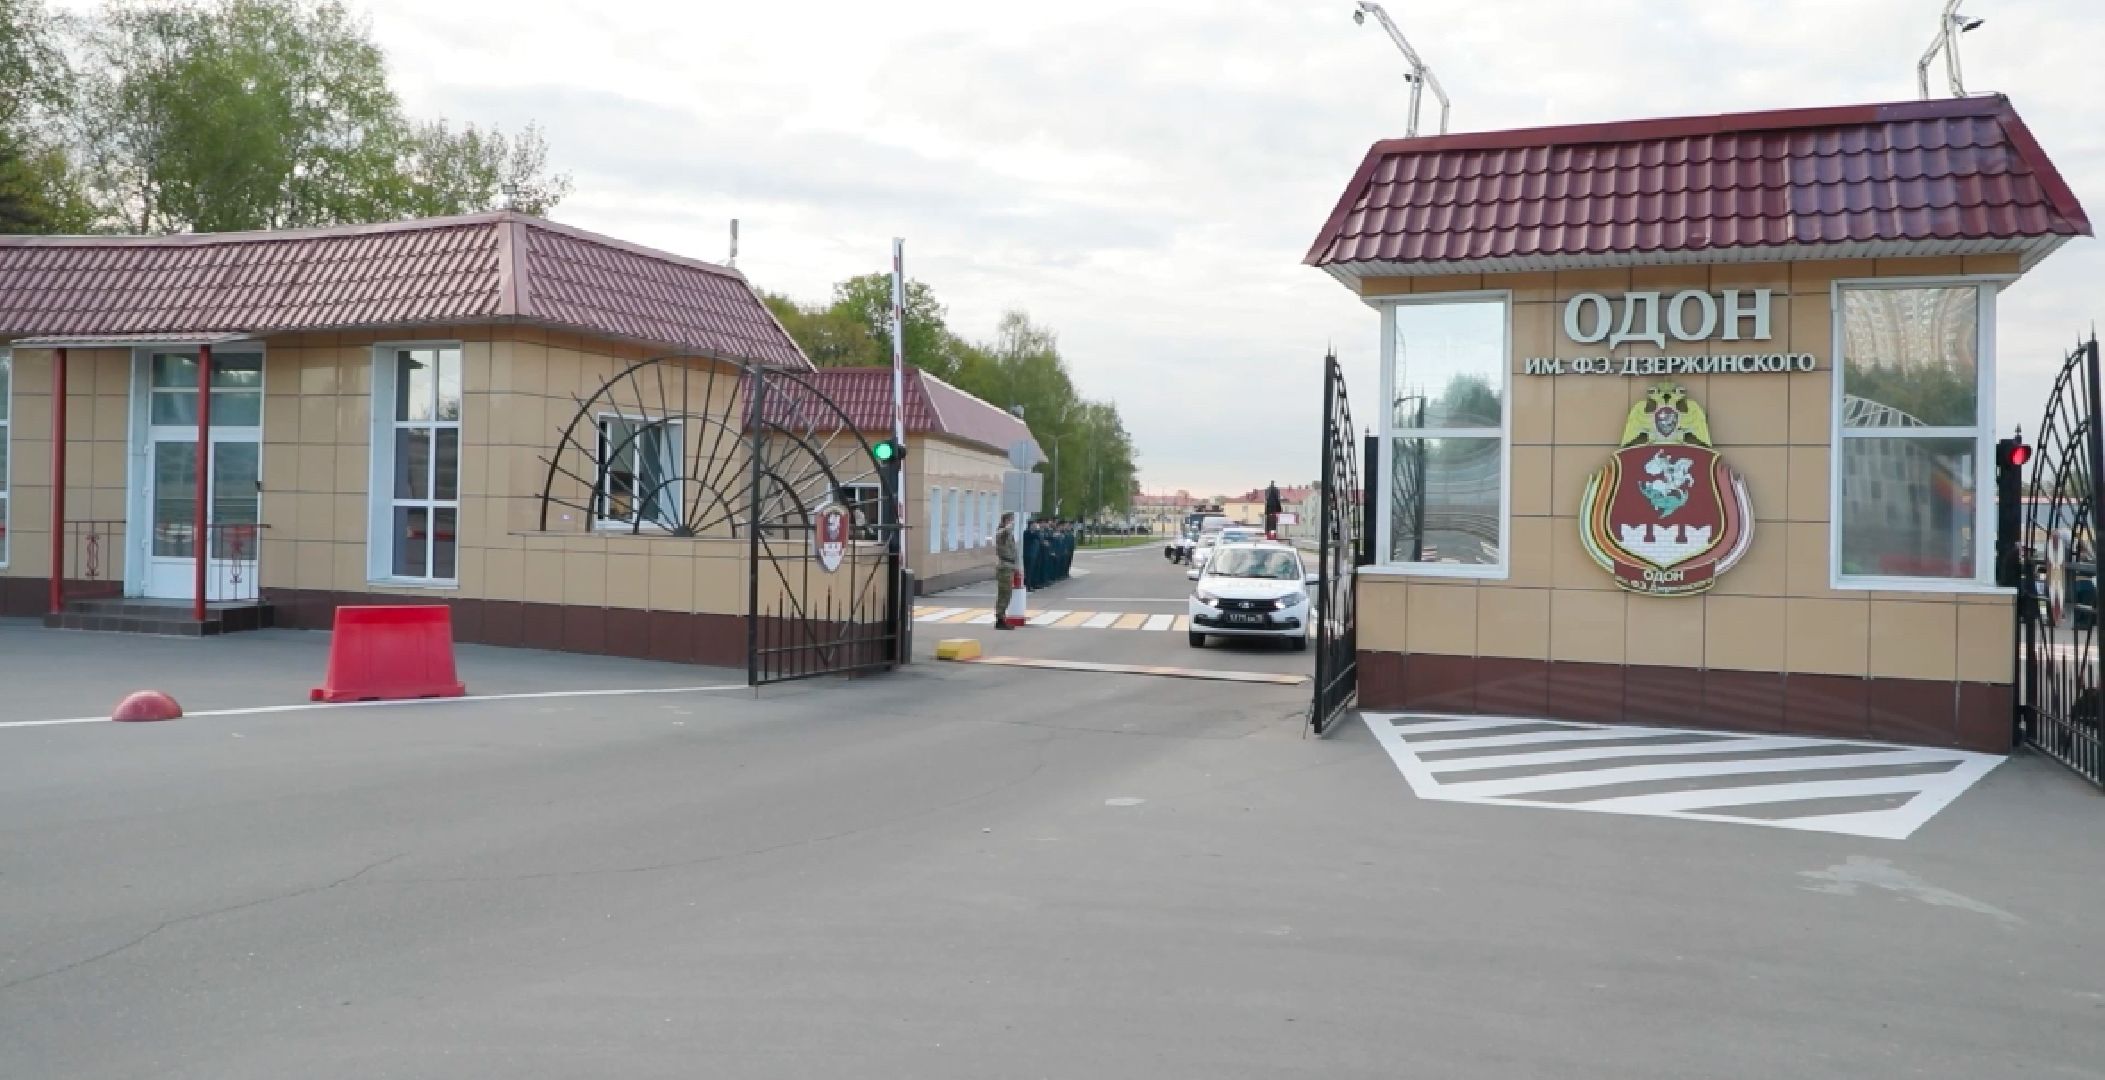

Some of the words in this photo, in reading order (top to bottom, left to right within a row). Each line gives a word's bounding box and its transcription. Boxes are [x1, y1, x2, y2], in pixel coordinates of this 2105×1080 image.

[1564, 288, 1772, 350] ОДОН
[1525, 356, 1565, 374] ИМ.
[1572, 356, 1615, 374] Ф.Э.
[1620, 352, 1816, 376] ДЗЕРЖИНСКОГО
[1643, 569, 1684, 584] ОДОН
